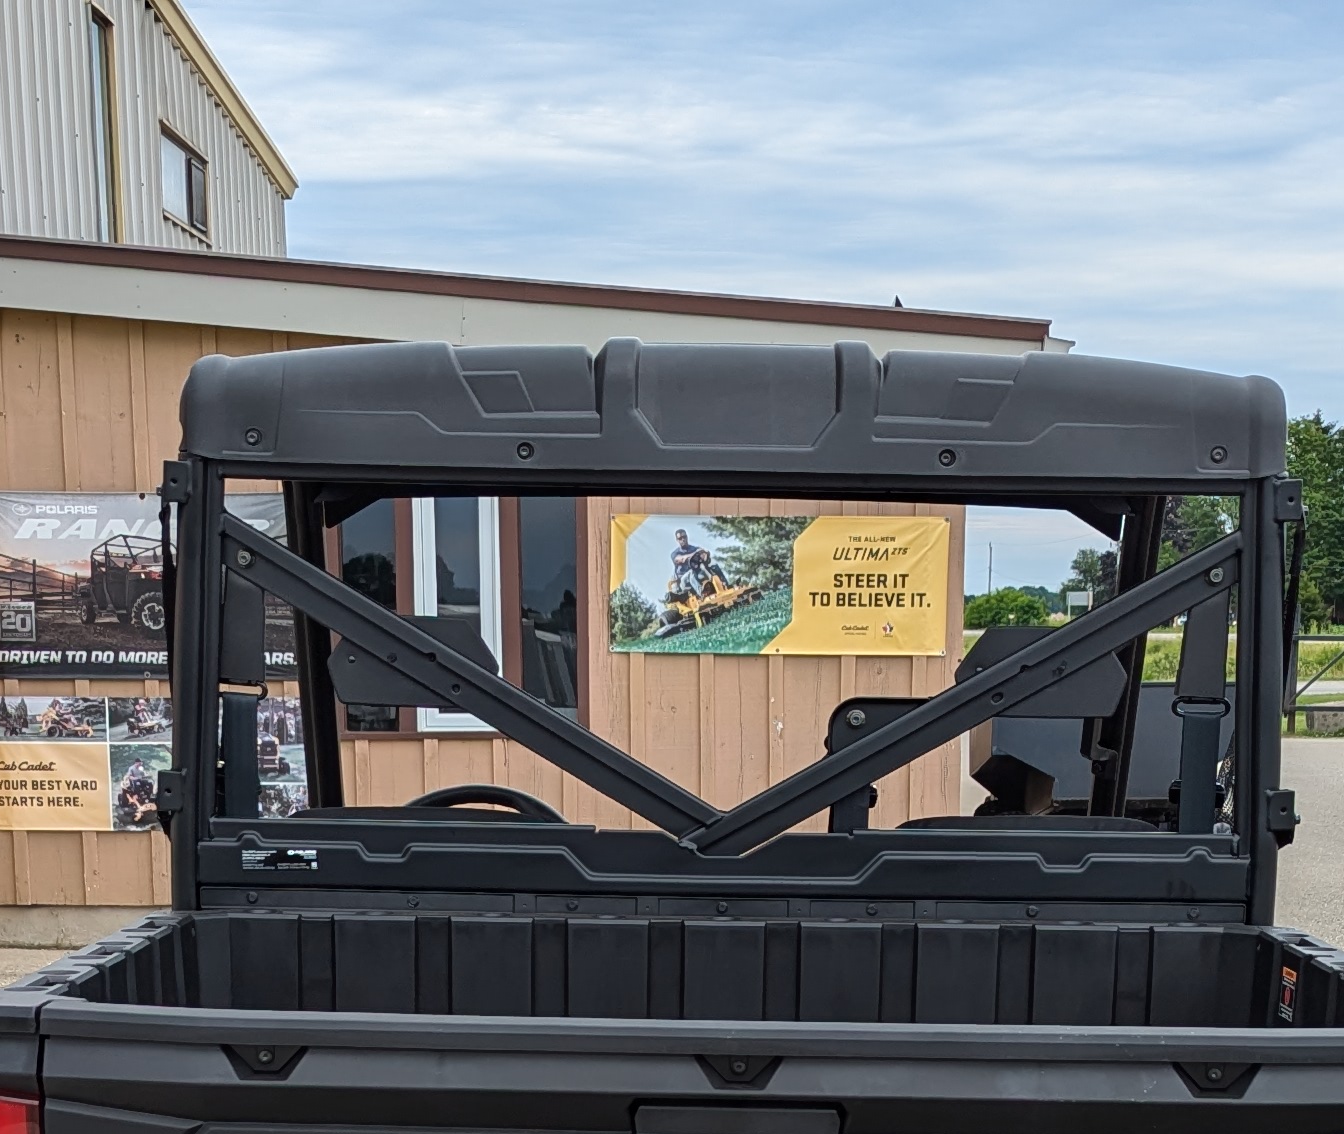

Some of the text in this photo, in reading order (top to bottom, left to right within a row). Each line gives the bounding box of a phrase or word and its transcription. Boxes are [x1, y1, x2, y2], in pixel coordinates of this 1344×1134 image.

[35, 505, 98, 515] POLARIS
[833, 547, 889, 561] ULTIMA
[833, 573, 909, 588] STEER IT
[809, 592, 931, 608] TO BELIEVE IT.
[1, 611, 32, 632] 20
[66, 651, 87, 664] TO
[91, 651, 114, 664] DO
[118, 651, 168, 664] MORE
[18, 761, 56, 771] Cadet
[31, 779, 62, 790] BEST
[65, 780, 98, 790] YARD
[47, 796, 84, 807] HERE.
